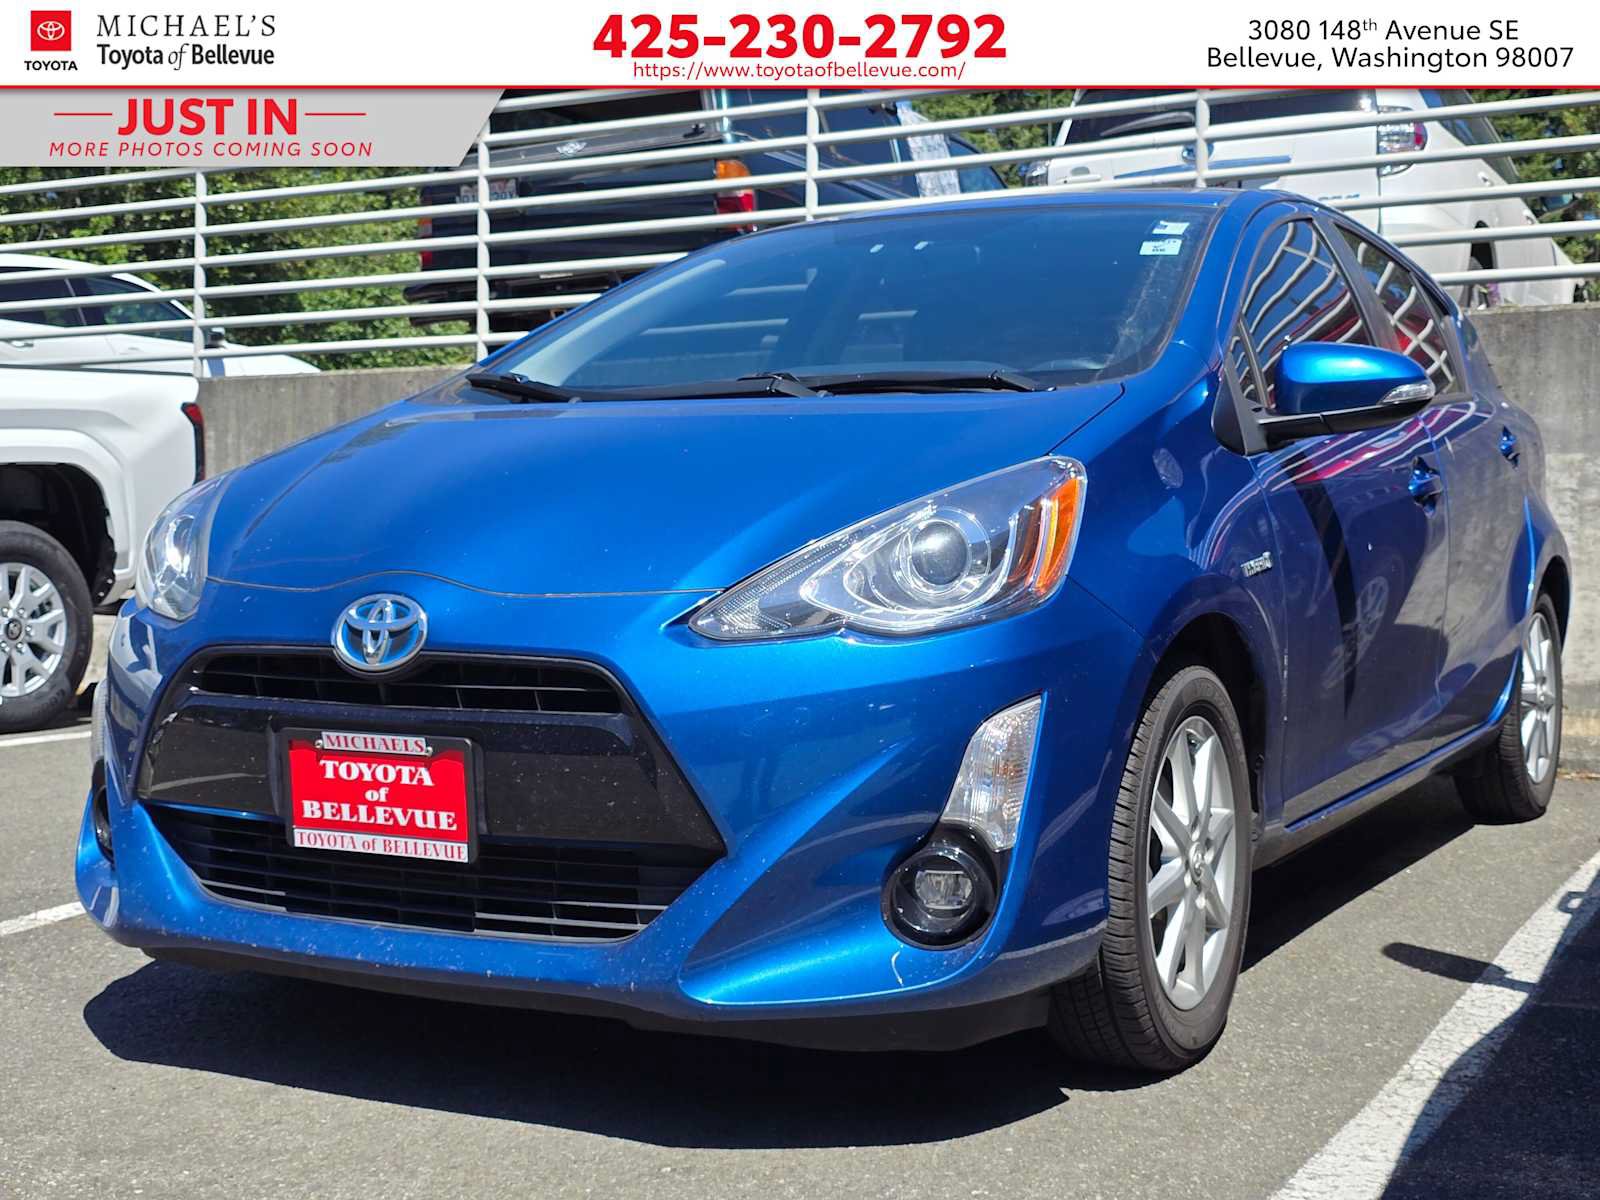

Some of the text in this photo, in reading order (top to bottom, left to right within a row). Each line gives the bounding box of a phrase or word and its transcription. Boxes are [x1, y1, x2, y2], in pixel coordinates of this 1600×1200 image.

[325, 734, 425, 754] MICHAELS
[320, 759, 435, 786] TOYOTA
[365, 787, 389, 802] of
[302, 800, 457, 831] BELLEVUE
[299, 831, 467, 861] TOYOTA of BELLEVUE
